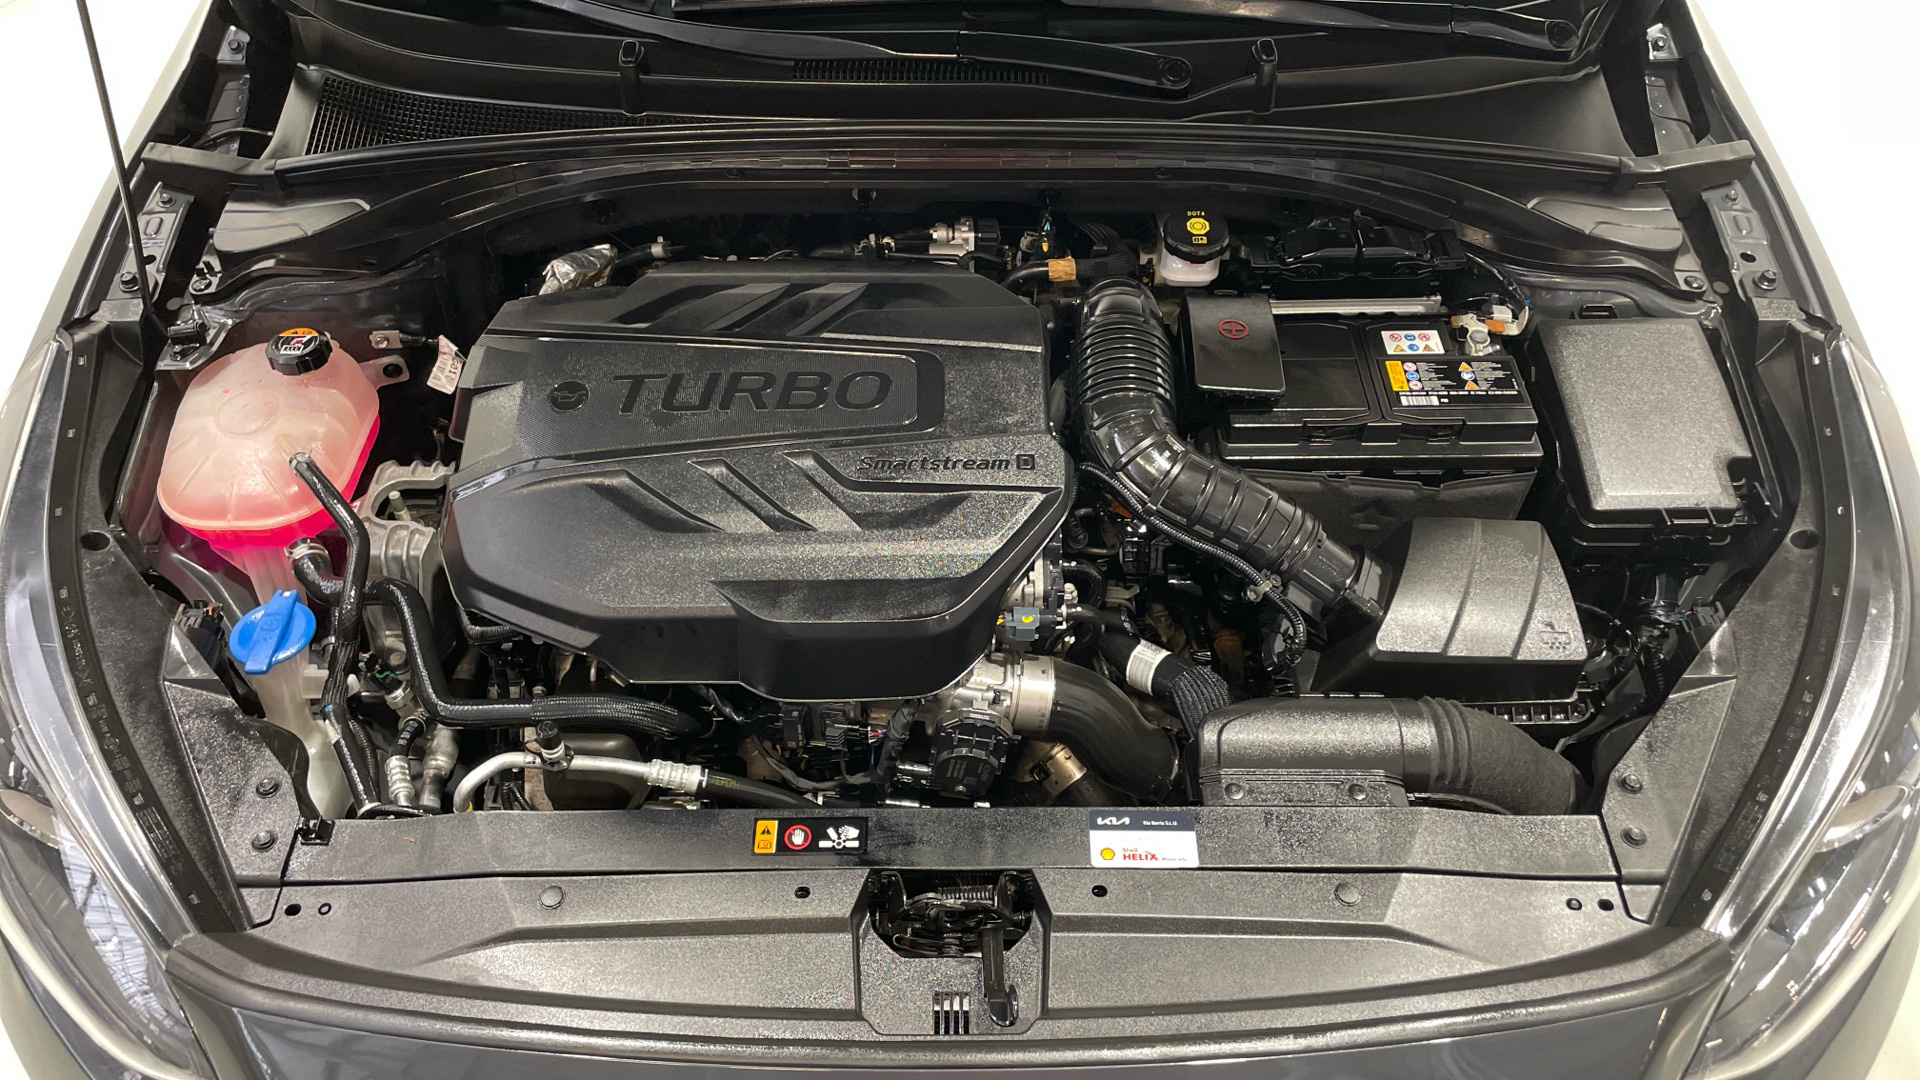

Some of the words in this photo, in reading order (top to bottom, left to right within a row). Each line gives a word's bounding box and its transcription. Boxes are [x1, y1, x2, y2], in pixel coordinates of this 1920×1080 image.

[613, 371, 893, 414] TURBO
[857, 456, 1011, 471] Smartstream
[1097, 817, 1130, 825] KIA
[1122, 850, 1159, 861] HELIX
